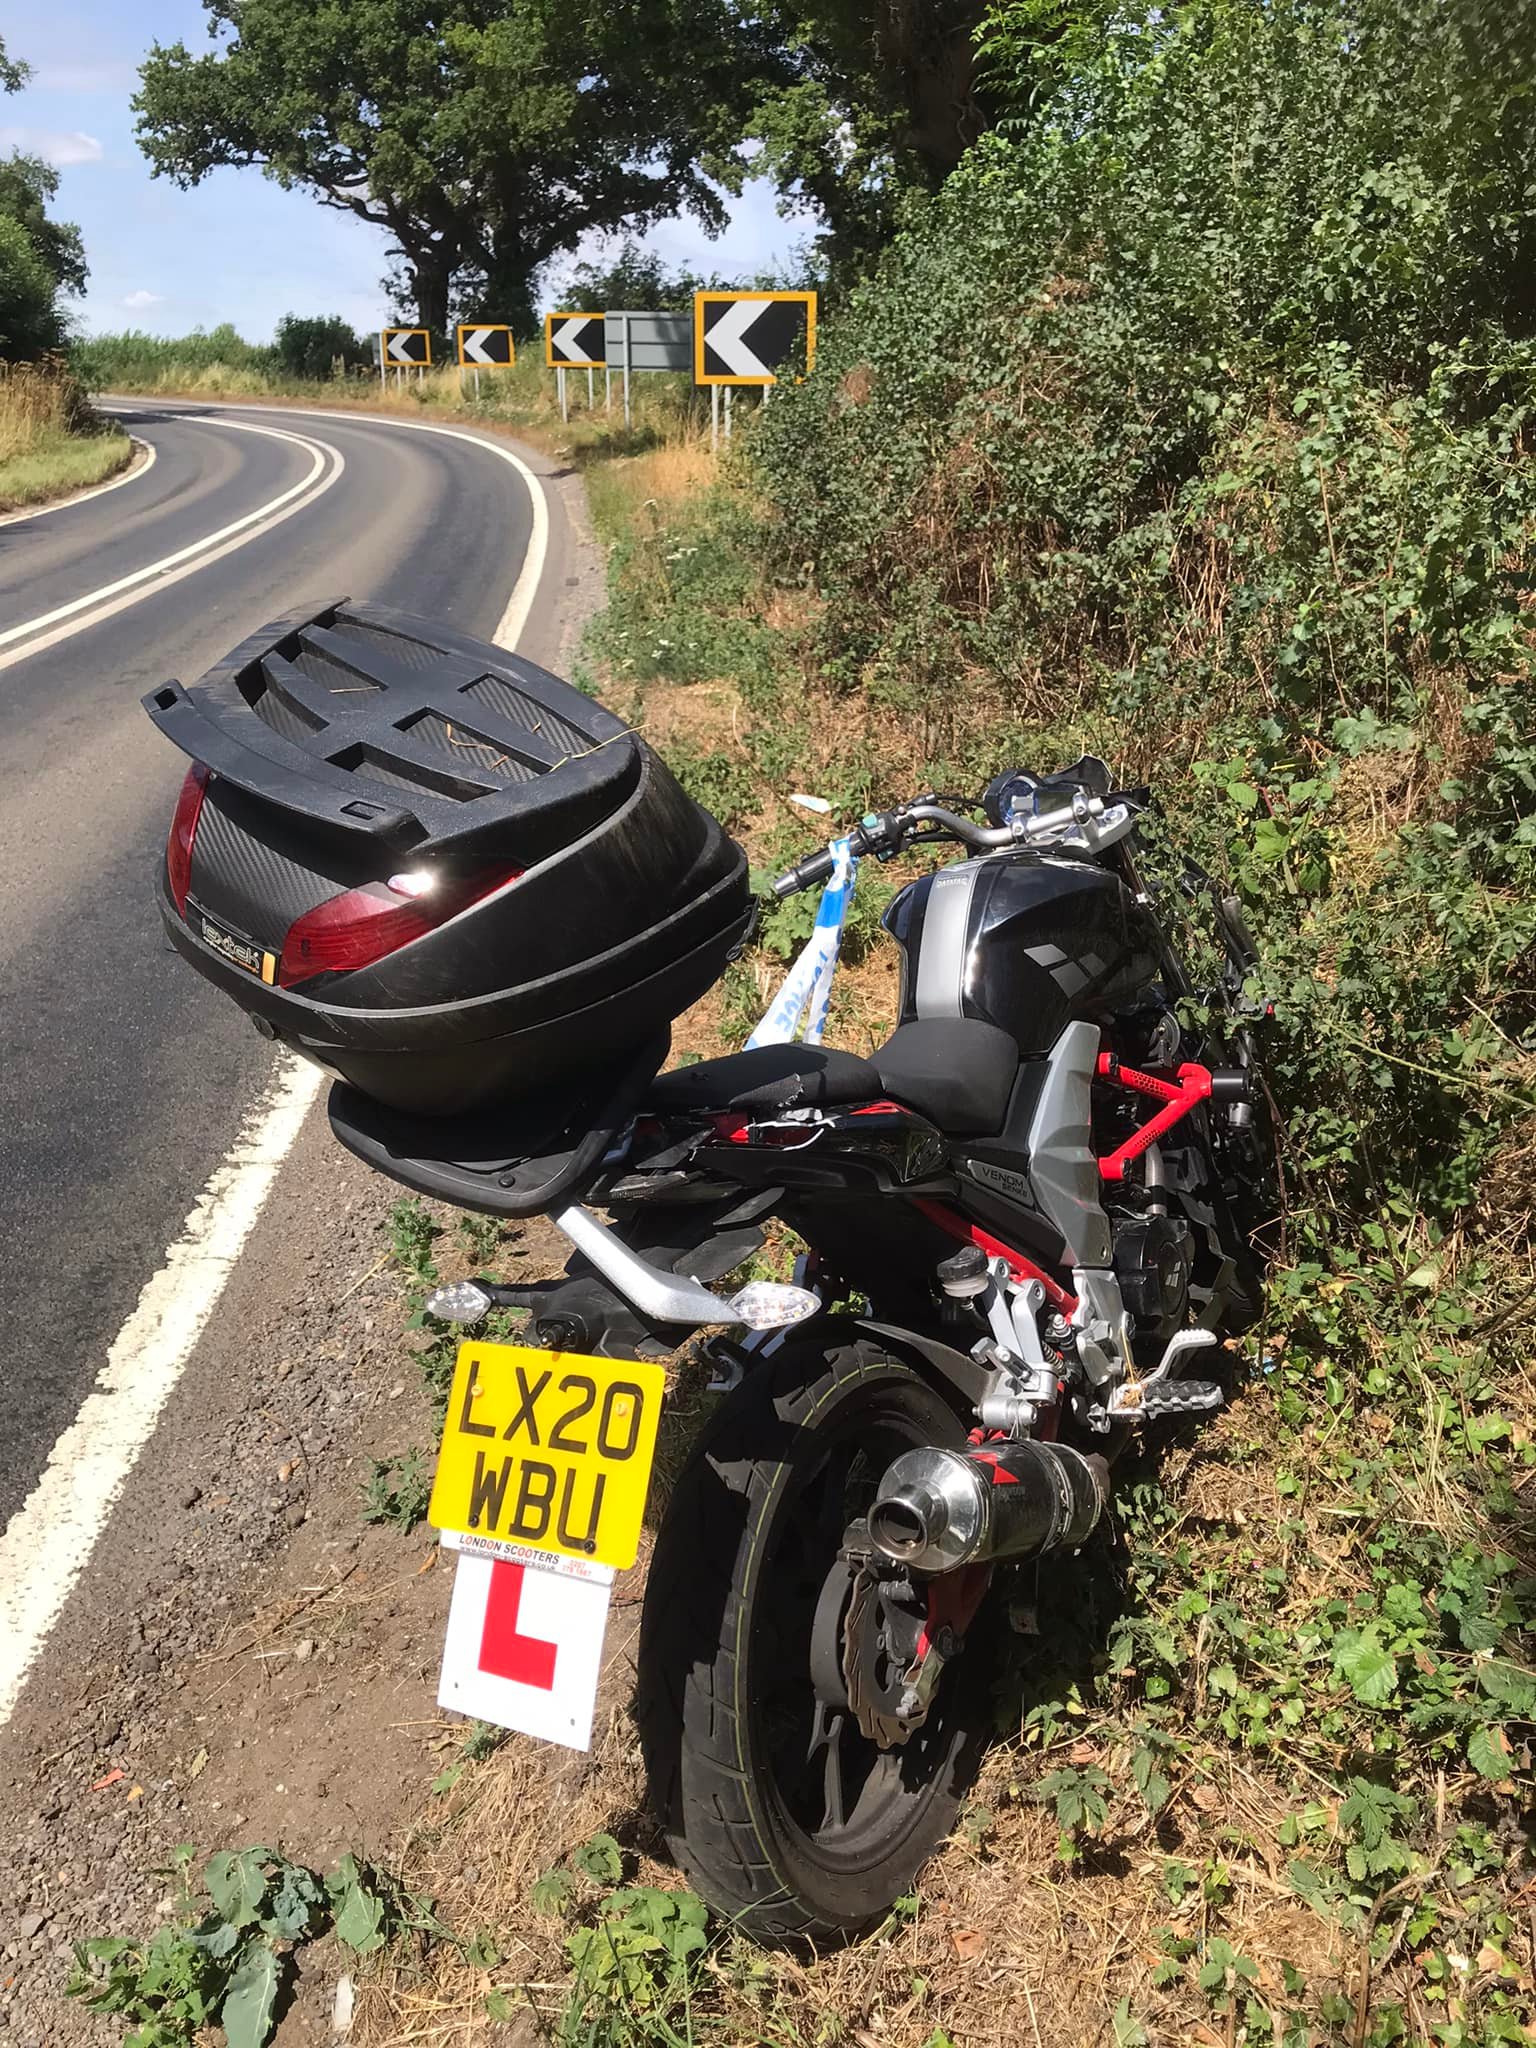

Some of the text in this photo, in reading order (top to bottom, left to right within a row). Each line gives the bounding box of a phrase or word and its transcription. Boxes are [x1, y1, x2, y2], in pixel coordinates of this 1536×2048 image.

[982, 1167, 1024, 1188] VENOM
[459, 1360, 644, 1461] LX20
[459, 1535, 560, 1565] LONDON SCOOTERS
[468, 1451, 606, 1554] WBU
[478, 1560, 558, 1691] L
